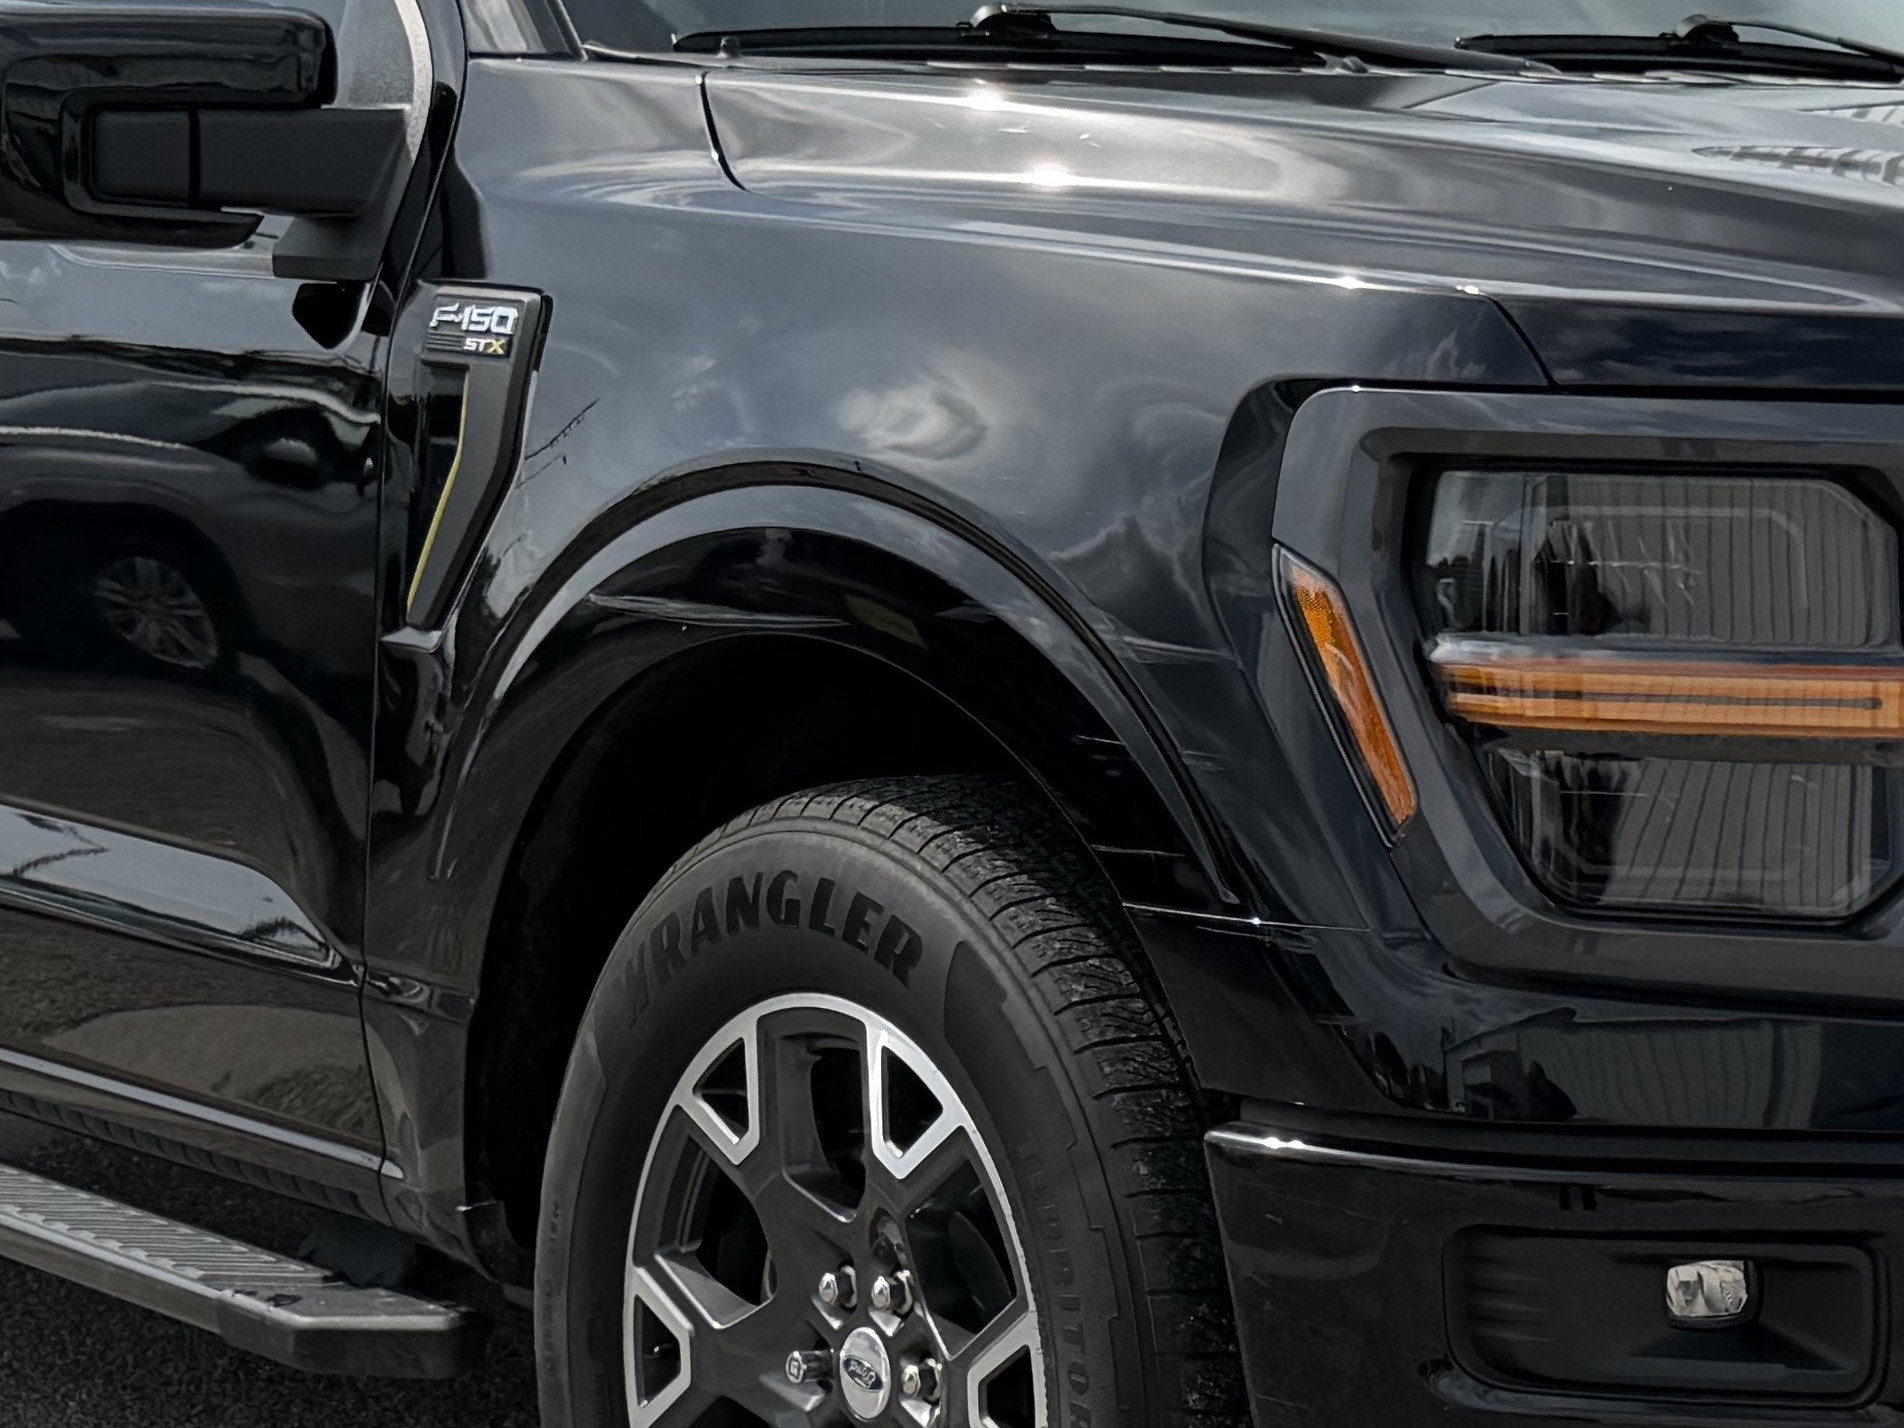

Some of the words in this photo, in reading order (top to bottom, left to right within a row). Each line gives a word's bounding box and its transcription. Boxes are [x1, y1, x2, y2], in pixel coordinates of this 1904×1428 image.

[429, 302, 519, 335] F-150
[463, 336, 507, 355] STX
[616, 868, 924, 1030] WRANGLER
